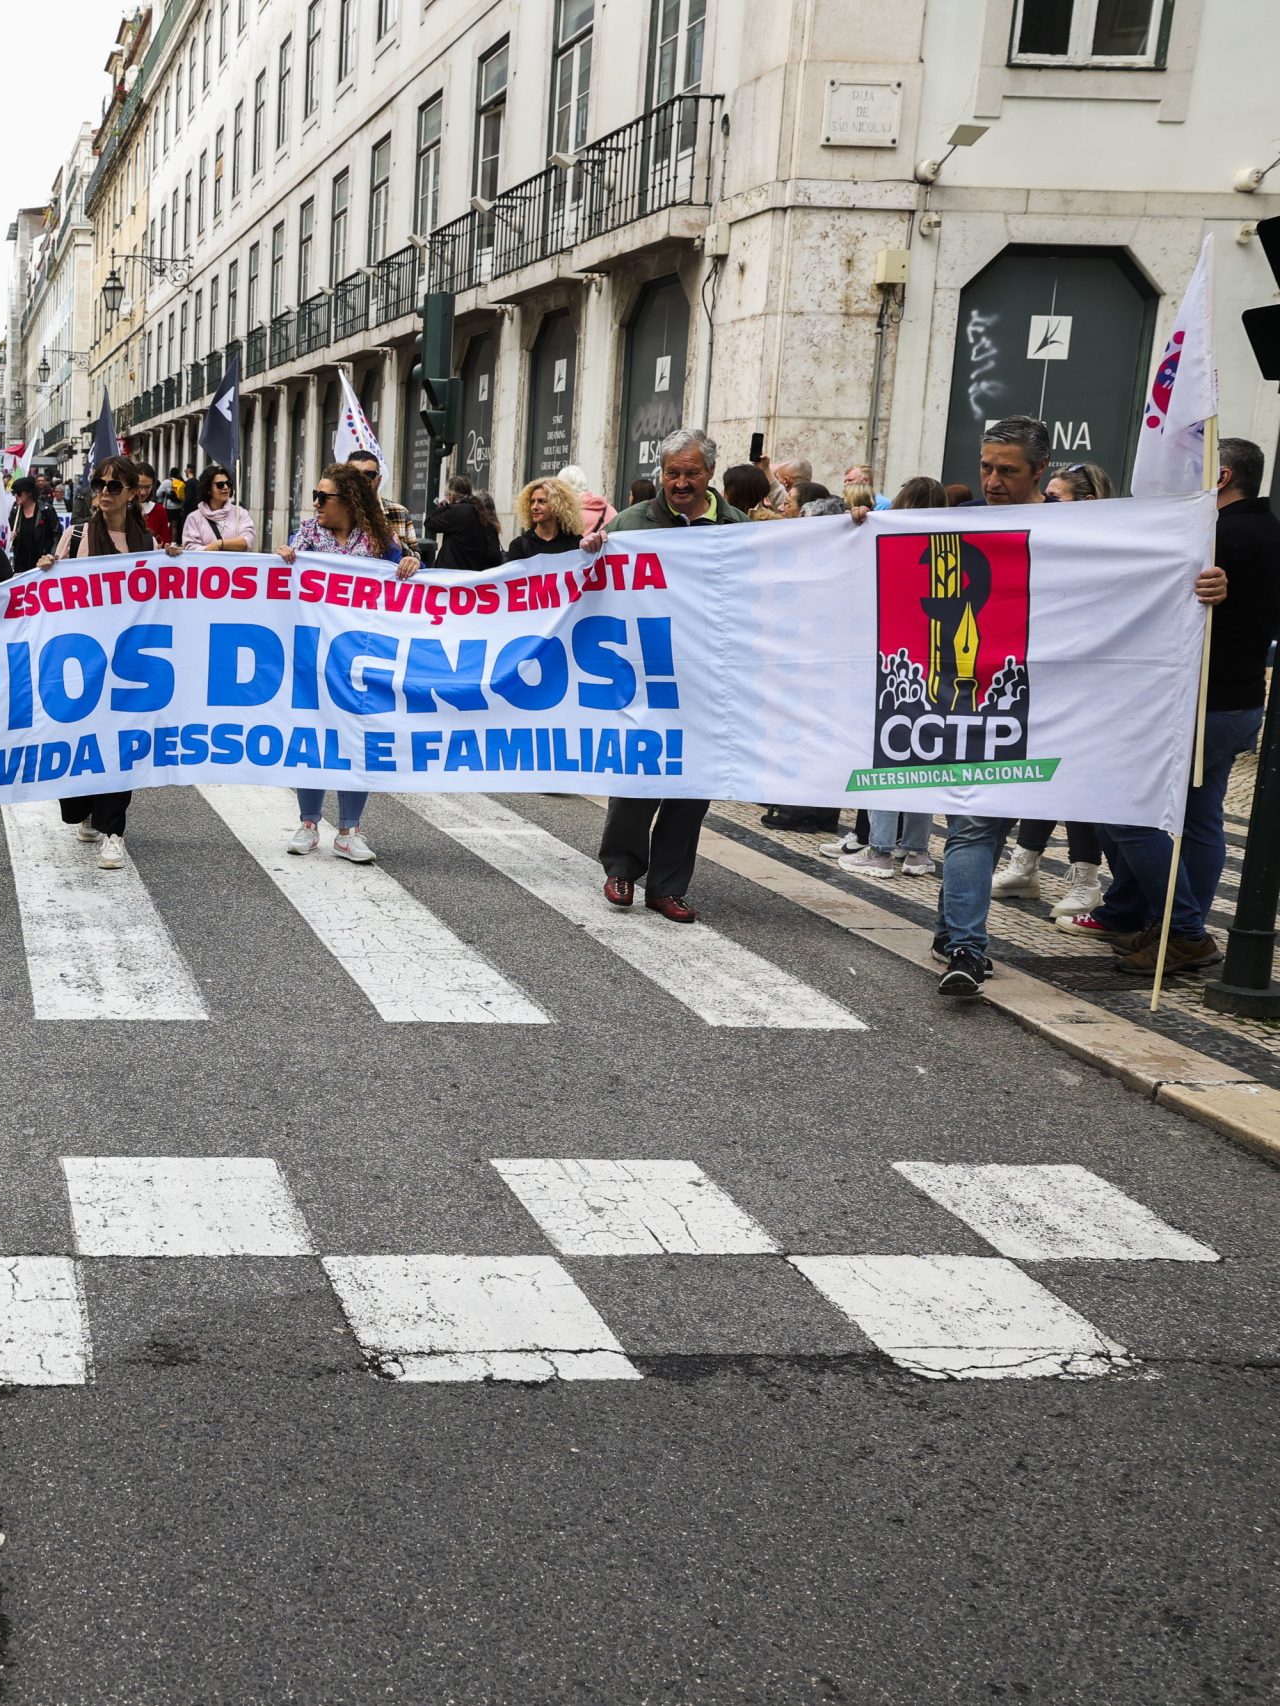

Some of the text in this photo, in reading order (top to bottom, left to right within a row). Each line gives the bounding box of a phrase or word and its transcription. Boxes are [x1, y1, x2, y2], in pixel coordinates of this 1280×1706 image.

[852, 90, 875, 101] RUA
[856, 106, 869, 118] DE
[1052, 421, 1092, 450] NA
[649, 441, 661, 463] SA
[4, 560, 258, 618] ESCRITÓRIOS
[267, 568, 291, 600] E
[299, 569, 500, 625] SERVIÇOS
[504, 573, 561, 612] EM
[207, 616, 680, 715] DIGNOS!
[118, 723, 351, 771] PESSOAL
[364, 731, 397, 772] E
[411, 728, 683, 776] FAMILIAR!
[880, 714, 1022, 761] CGTP
[856, 766, 1045, 786] INTERSINDICAL NACIONAL
